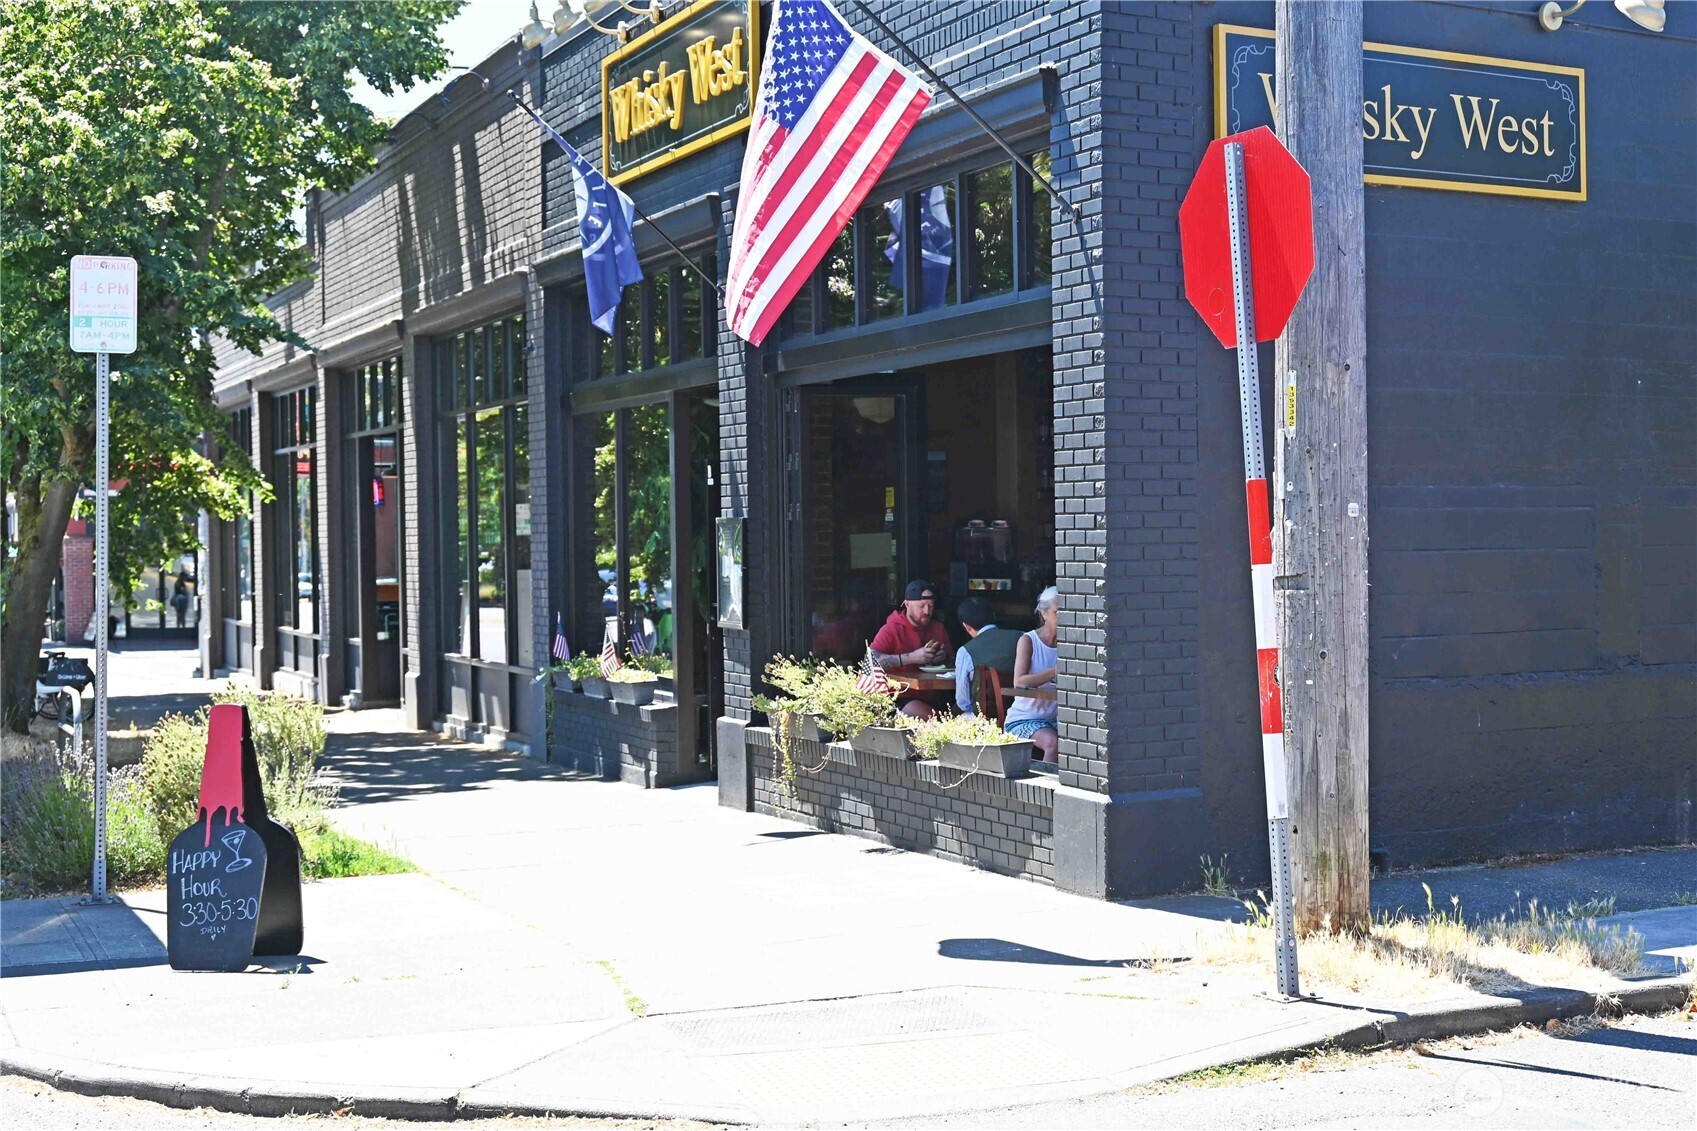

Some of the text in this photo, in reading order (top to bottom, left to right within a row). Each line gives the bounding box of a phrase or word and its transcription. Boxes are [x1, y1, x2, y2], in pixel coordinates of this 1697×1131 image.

[609, 27, 748, 143] Whisky West
[1449, 93, 1555, 157] West
[93, 260, 133, 271] PARKING
[79, 318, 128, 328] 2 HOUR
[172, 849, 221, 874] HAPPY
[181, 874, 227, 900] HOUR
[180, 897, 258, 927] 3:30-5:30
[200, 925, 226, 935] DAILY
